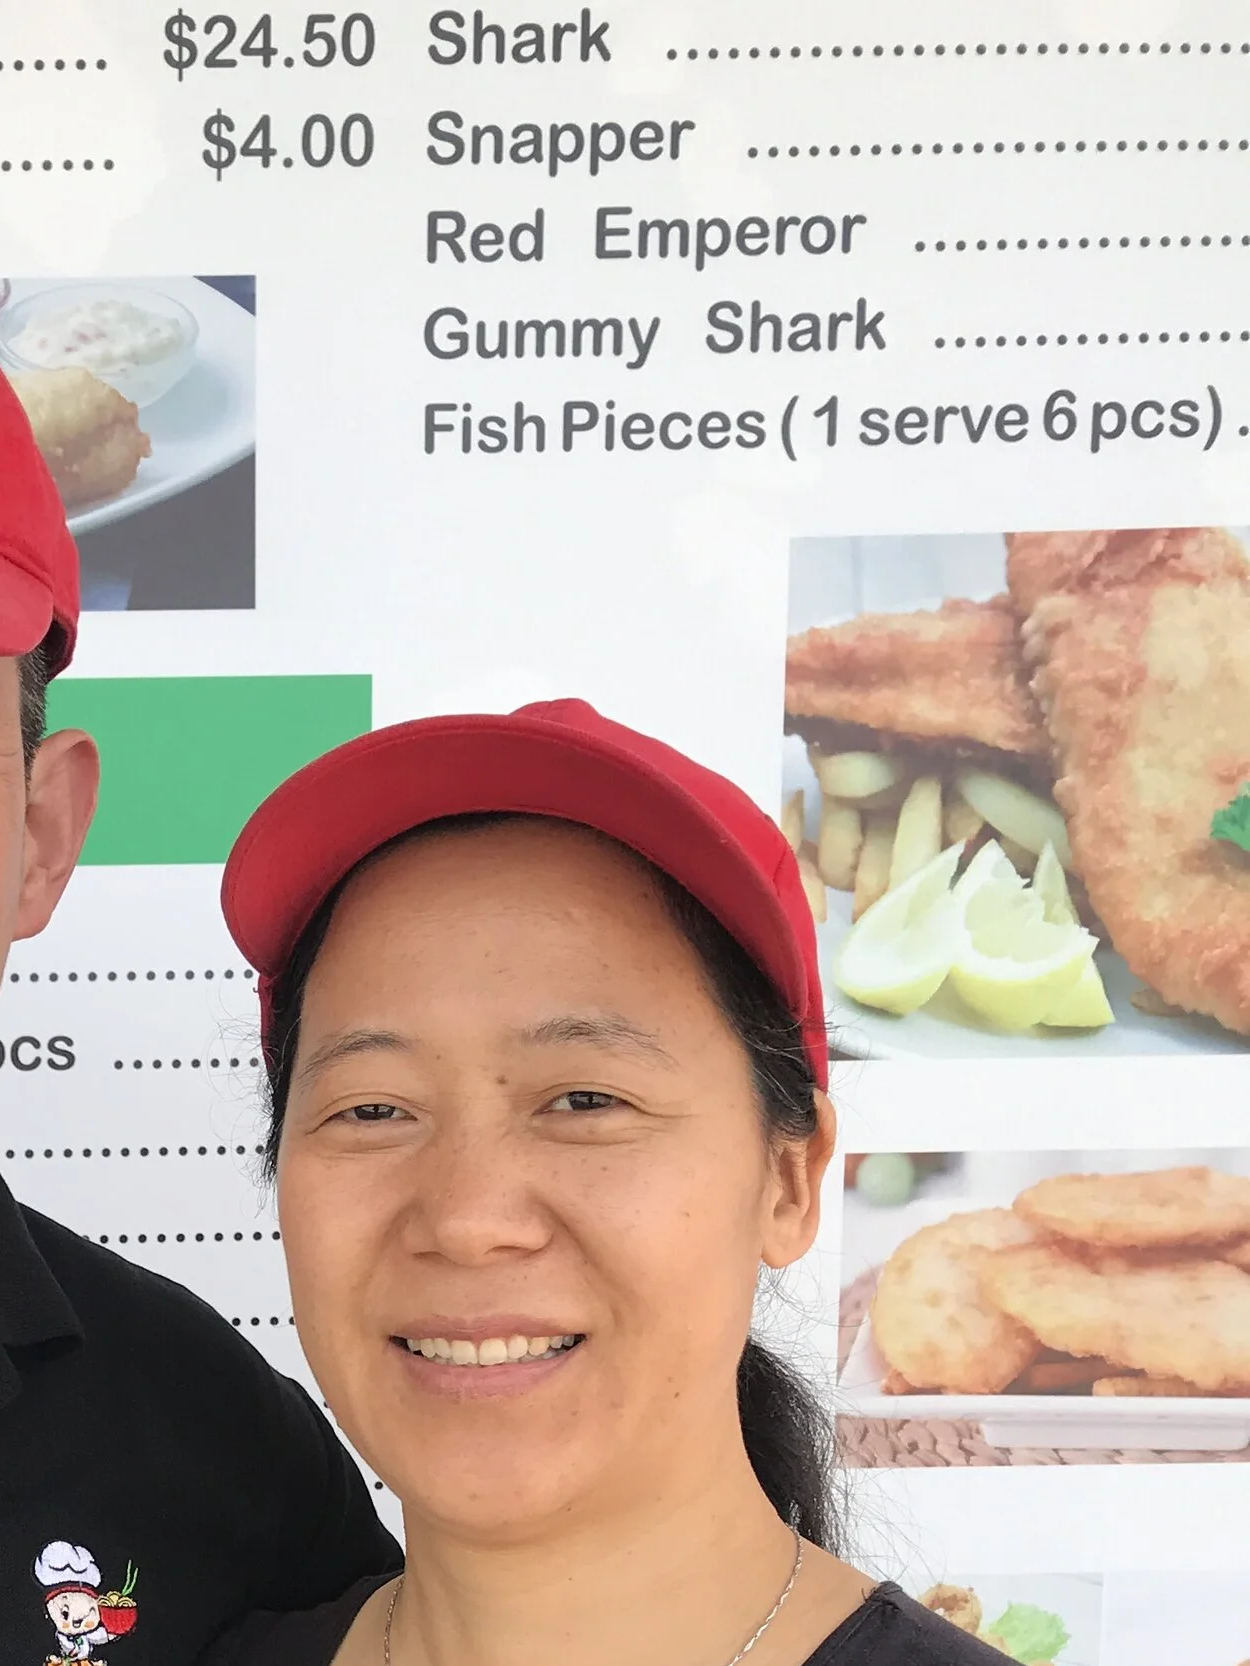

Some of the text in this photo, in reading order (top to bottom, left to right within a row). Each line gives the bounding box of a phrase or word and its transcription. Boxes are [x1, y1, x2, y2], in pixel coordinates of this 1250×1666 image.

[163, 7, 376, 83] $24.50
[428, 7, 612, 66] Shark
[202, 108, 374, 182] $4.00
[426, 110, 696, 178] Snapper
[426, 206, 867, 272] Red Emperor
[423, 297, 886, 370] Gummy Shark
[424, 401, 546, 455] Fish
[562, 400, 766, 453] Pieces
[859, 403, 1029, 446] serve
[1043, 389, 1077, 441] 6
[1090, 384, 1222, 454] pcs)
